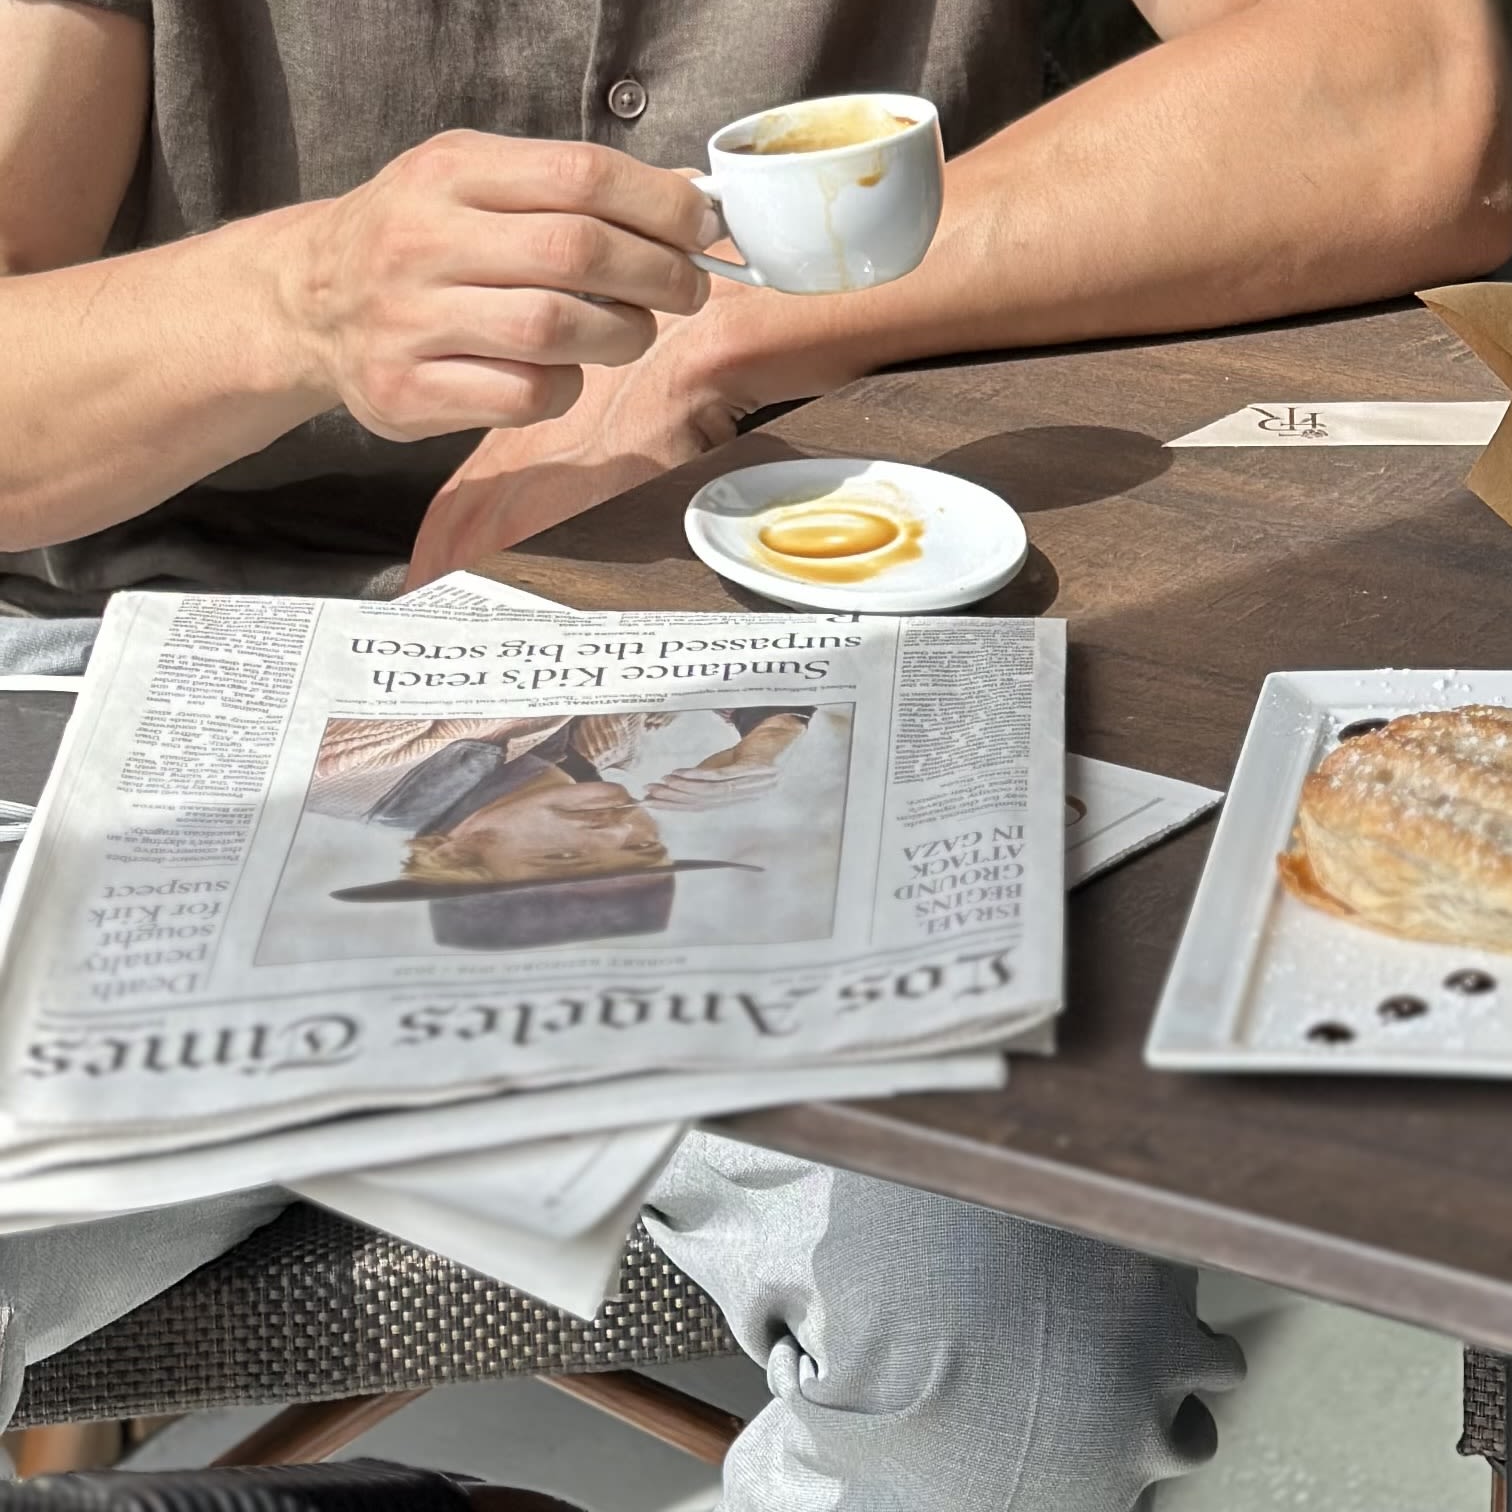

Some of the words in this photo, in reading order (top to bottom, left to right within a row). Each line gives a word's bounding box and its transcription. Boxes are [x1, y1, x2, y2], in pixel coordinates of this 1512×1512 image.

[352, 638, 487, 661] screen
[496, 638, 563, 662] big
[577, 641, 643, 660] the
[659, 633, 862, 657] surpassed
[373, 670, 487, 693] reach
[499, 665, 607, 690] Kid's
[622, 659, 830, 685] Sundance
[993, 825, 1023, 840] IN
[904, 832, 982, 861] GAZA
[912, 845, 1024, 879] ATTACK
[104, 880, 230, 898] suspect
[894, 864, 1024, 900] GROUND
[171, 902, 221, 920] for
[916, 884, 1022, 917] BEGINS
[88, 905, 161, 928] Kirk
[919, 903, 1020, 935] ISRAEL
[98, 924, 214, 949] sought
[82, 944, 206, 974] penalty
[91, 974, 199, 1002] Death
[833, 945, 1017, 1015] Los
[394, 986, 823, 1048] Angeles
[23, 1014, 360, 1082] Times
